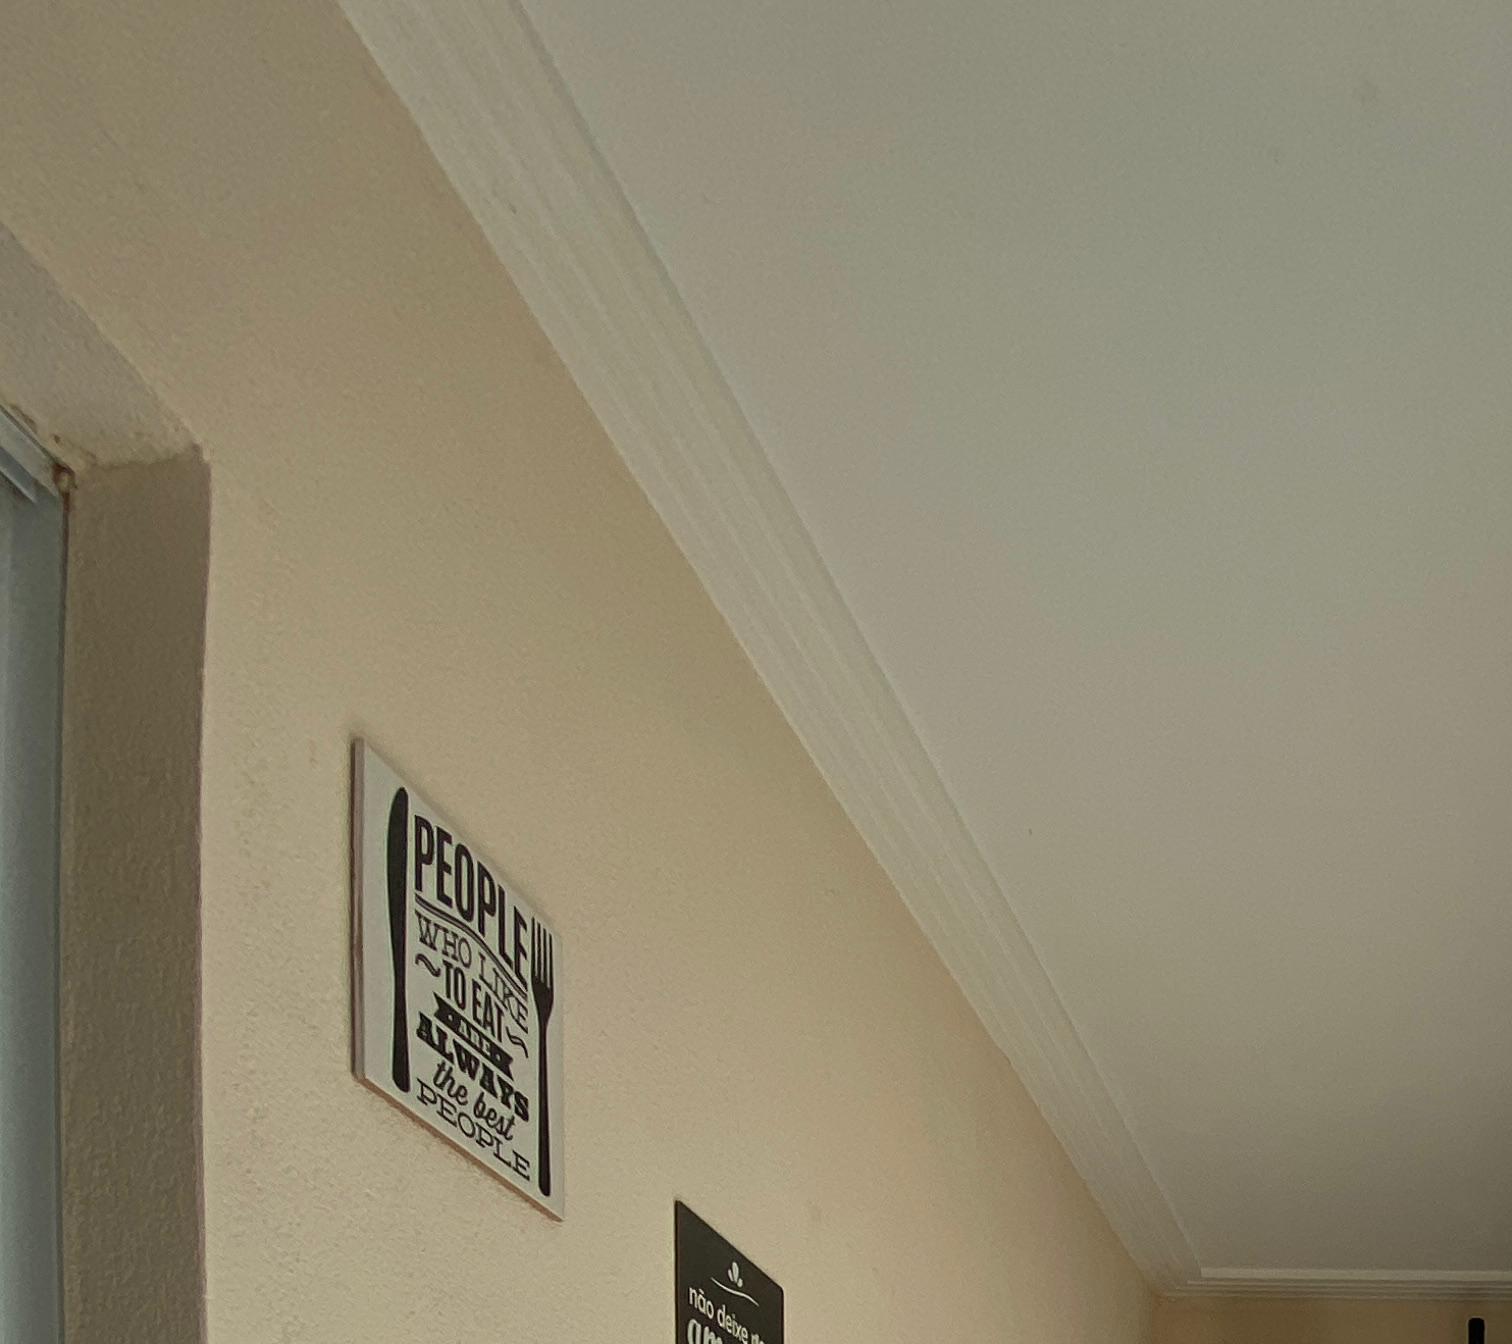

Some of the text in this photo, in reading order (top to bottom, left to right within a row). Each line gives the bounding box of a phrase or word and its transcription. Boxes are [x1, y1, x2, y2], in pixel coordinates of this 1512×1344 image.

[414, 815, 528, 990] PEOPLE
[414, 911, 528, 1034] WHO LIKE
[443, 956, 504, 1042] TO EAT
[416, 1010, 529, 1122] ALWAYS
[432, 1059, 515, 1141] the best
[416, 1076, 530, 1181] PEOPLE
[689, 1286, 715, 1320] não
[717, 1305, 749, 1344] deixe
